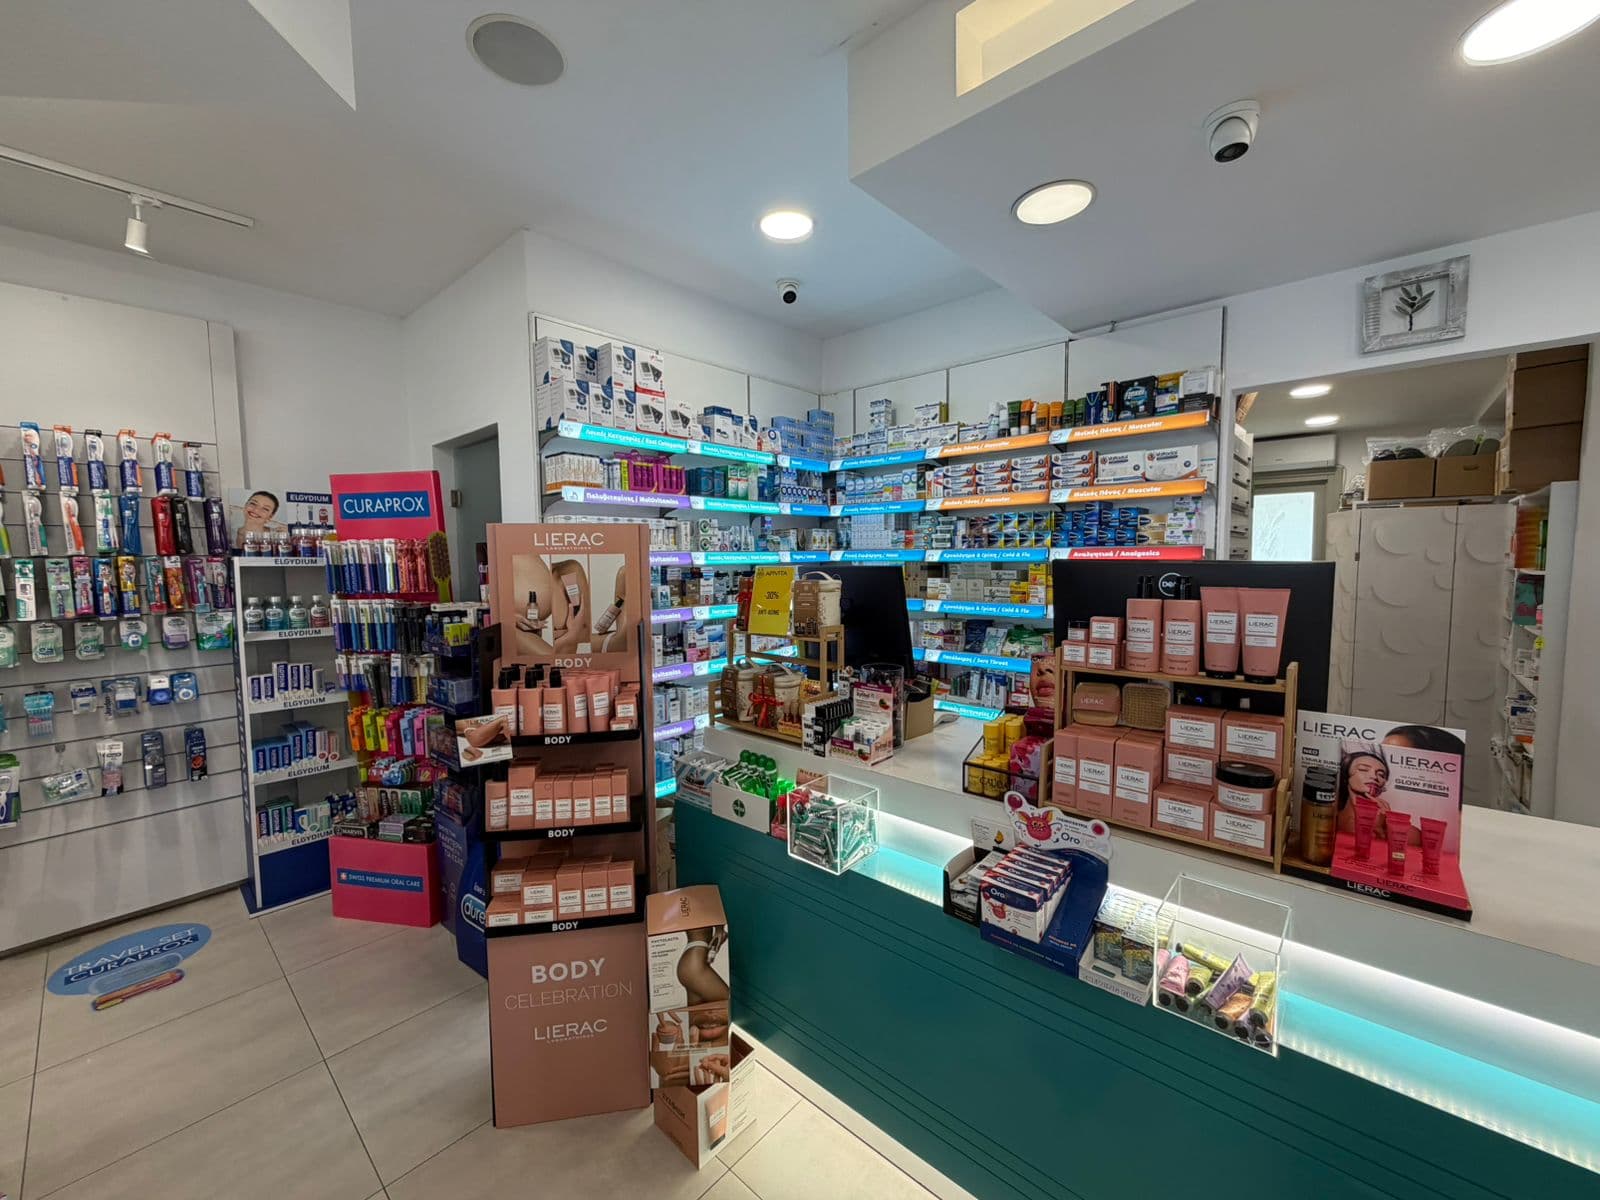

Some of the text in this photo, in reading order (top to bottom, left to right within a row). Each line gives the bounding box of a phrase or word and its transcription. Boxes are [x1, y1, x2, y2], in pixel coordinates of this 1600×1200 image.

[1127, 421, 1164, 431] Muscular
[1127, 486, 1163, 495] Muscular
[289, 494, 329, 502] ELGYDIUM
[343, 496, 425, 514] CURAPROX
[533, 532, 605, 546] LIERAC
[1119, 550, 1161, 559] Analgesics
[274, 558, 318, 566] ELGYDIUM
[1209, 618, 1234, 626] LIERAC
[1248, 620, 1275, 628] LIERAC
[278, 629, 322, 638] ELGYDIUM
[1127, 626, 1152, 634] LIERAC
[1167, 628, 1193, 636] LIERAC
[554, 657, 593, 669] BODY
[989, 658, 1009, 667] Throat
[283, 696, 327, 709] ELGYDIUM
[1080, 697, 1105, 706] LIERAC
[1179, 725, 1204, 733] LIERAC
[1303, 720, 1376, 741] LIERAC
[544, 735, 572, 745] BODY
[1237, 733, 1264, 743] LIERAC
[1177, 760, 1202, 769] LIERAC
[1389, 753, 1457, 773] LIERAC
[287, 763, 330, 778] ELGYDIUM
[1082, 766, 1106, 776] LIERAC
[1120, 774, 1145, 784] LIERAC
[1394, 778, 1451, 792] GLOW FRESH
[1225, 794, 1250, 804] LIERAC
[1167, 804, 1193, 815] LIERAC
[1225, 819, 1253, 830] LIERAC
[291, 829, 334, 846] ELGYDIUM
[341, 827, 364, 837] MARVIS
[547, 828, 575, 838] BODY
[1060, 831, 1081, 846] Oro
[348, 873, 421, 888] SWISS PREMIUM ORAL CARE
[1376, 877, 1415, 892] LIERAC
[1346, 880, 1392, 898] LIERAC
[463, 899, 486, 925] dure
[681, 896, 690, 918] LIERAC
[551, 920, 579, 932] BODY
[64, 927, 196, 976] TRAVEL SET
[70, 936, 195, 983] CURAPROX
[531, 957, 606, 984] BODY
[504, 979, 633, 1010] CELEBRATION
[534, 1018, 608, 1041] LIERAC
